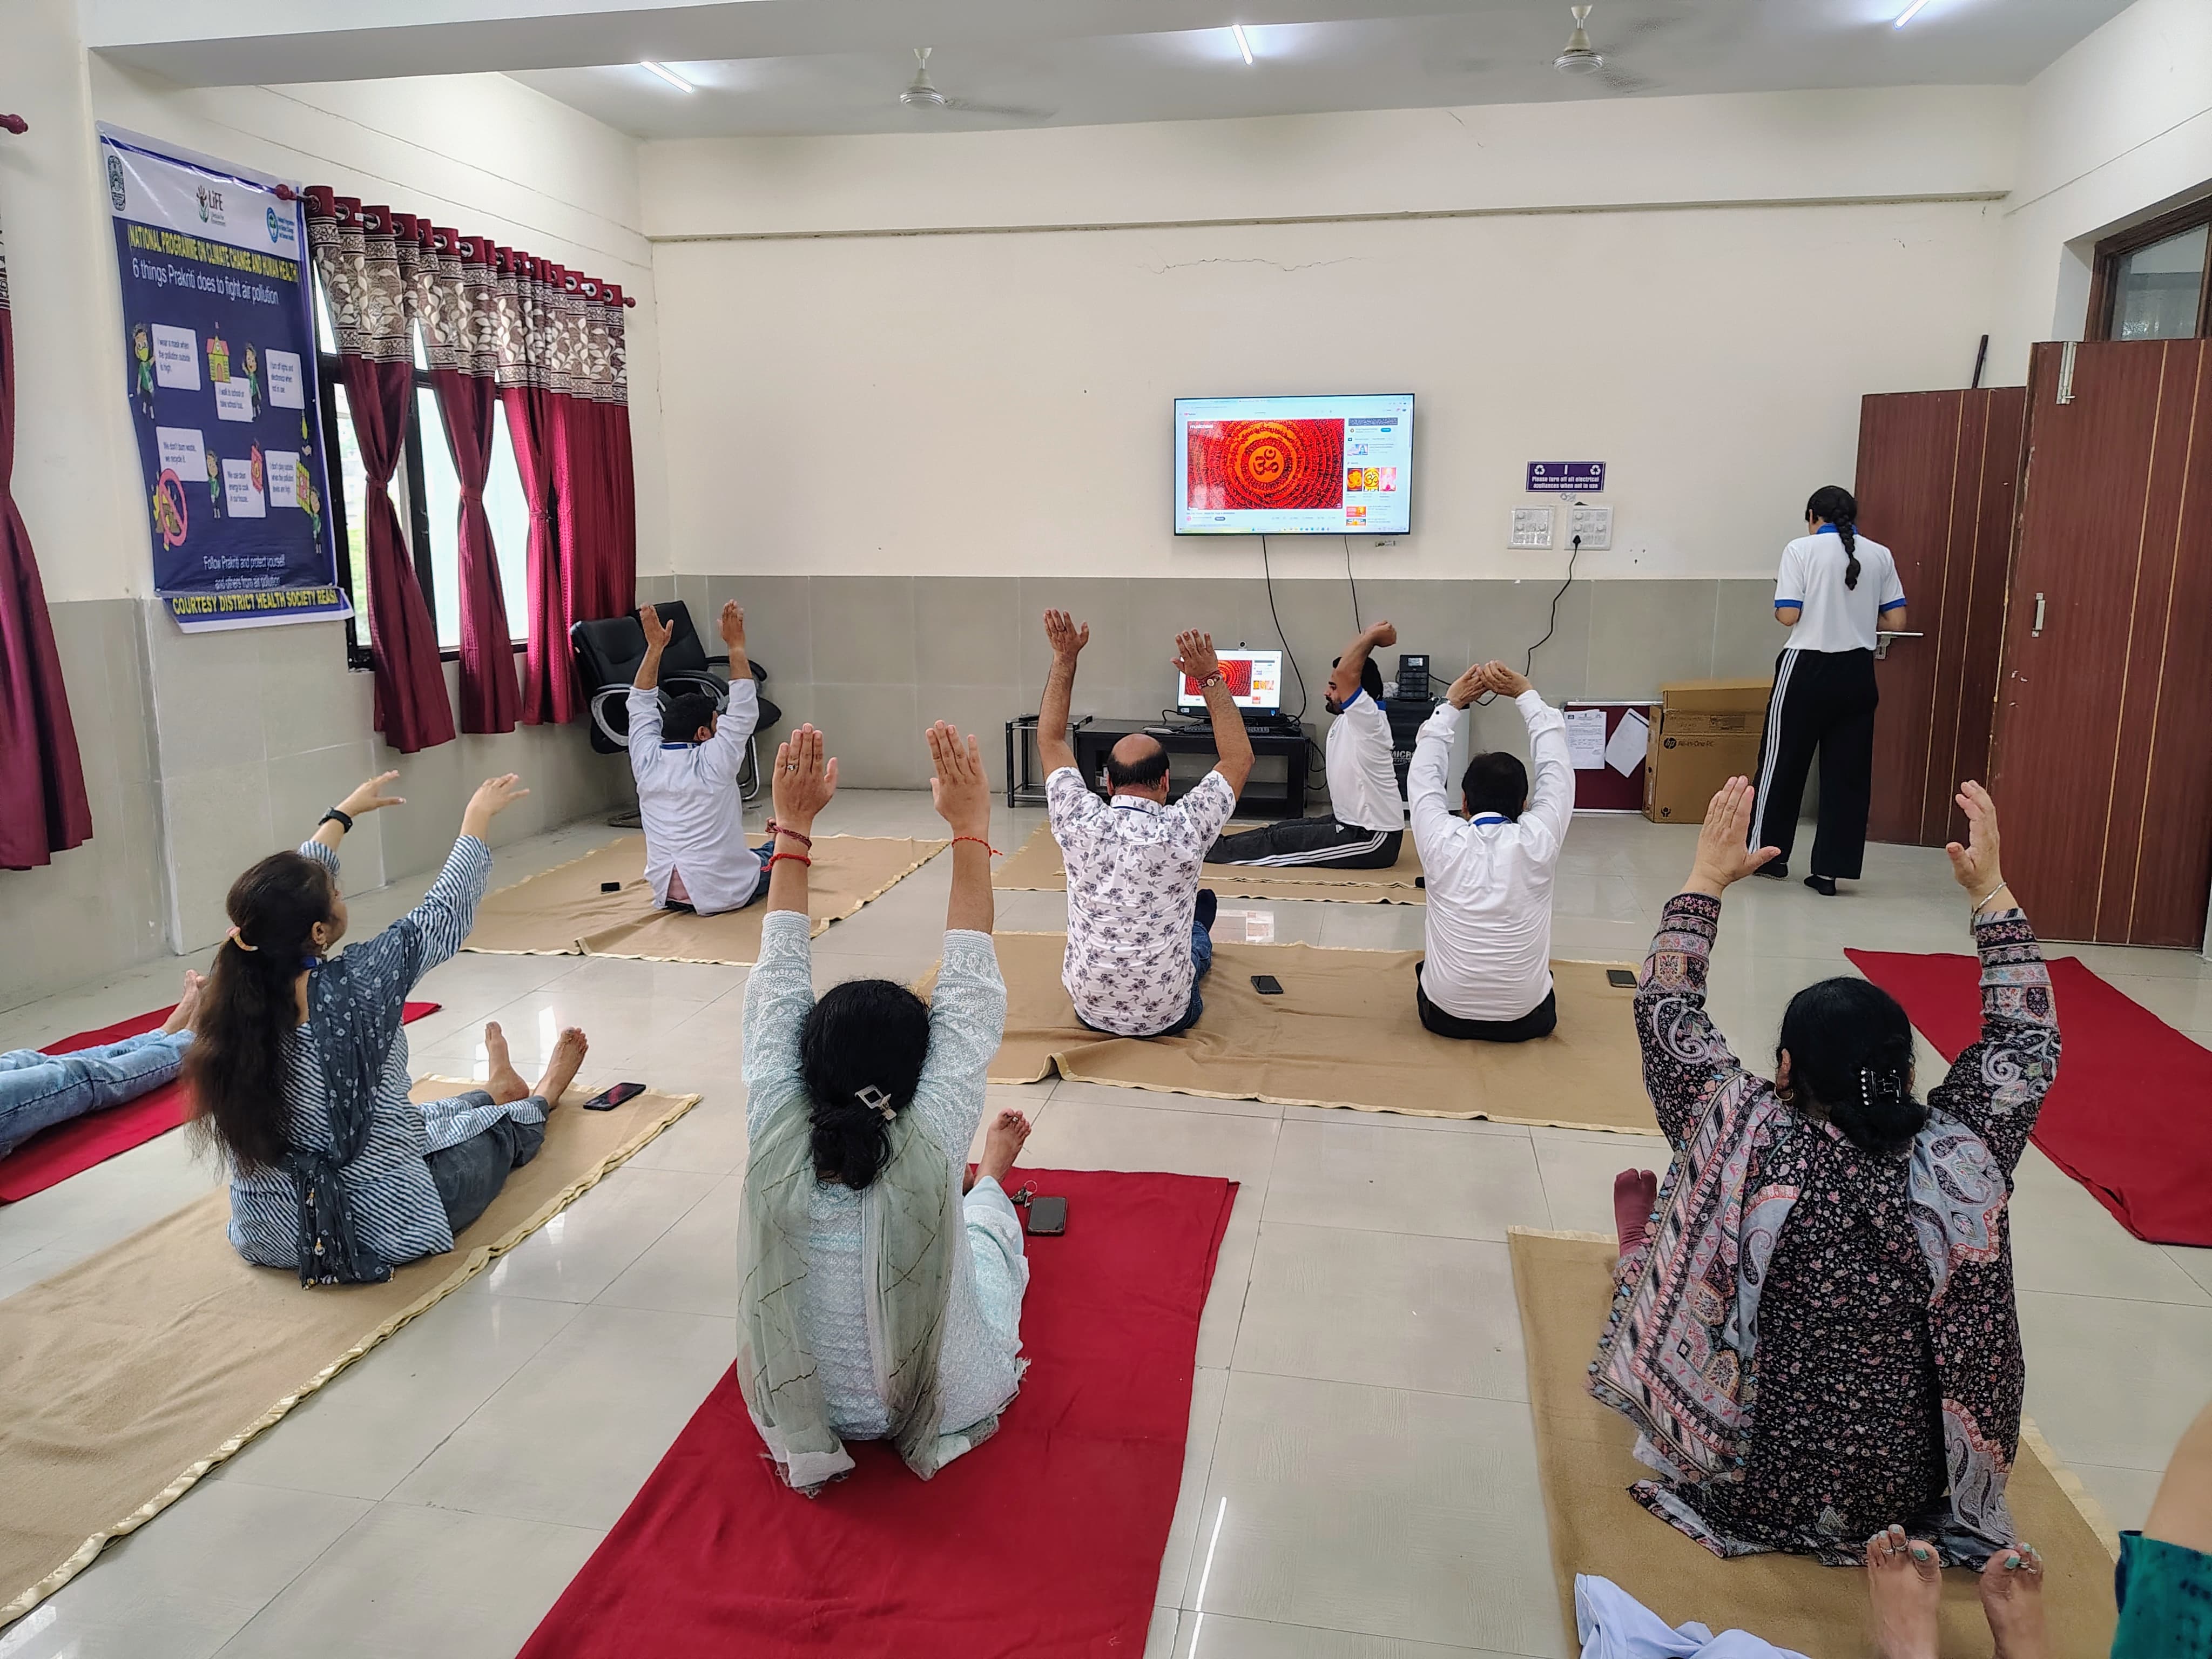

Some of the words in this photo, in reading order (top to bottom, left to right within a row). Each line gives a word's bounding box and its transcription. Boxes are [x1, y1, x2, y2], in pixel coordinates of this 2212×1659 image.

[208, 190, 224, 211] LiFE
[127, 224, 162, 252] NATIONAL
[132, 257, 139, 278] 6
[140, 259, 167, 288] things
[167, 264, 195, 289] Prakriti
[197, 271, 216, 293] does
[216, 276, 225, 295] to
[225, 275, 242, 301] fight
[241, 280, 251, 300] air
[251, 283, 279, 305] pollution
[203, 555, 221, 570] Follow
[240, 555, 250, 569] and
[266, 554, 286, 571] yourself
[172, 596, 217, 615] COURTESY
[219, 593, 255, 611] DISTRICT
[255, 591, 286, 609] HEALTH
[286, 590, 316, 607] SOCIETY
[1664, 737, 1677, 750] hp
